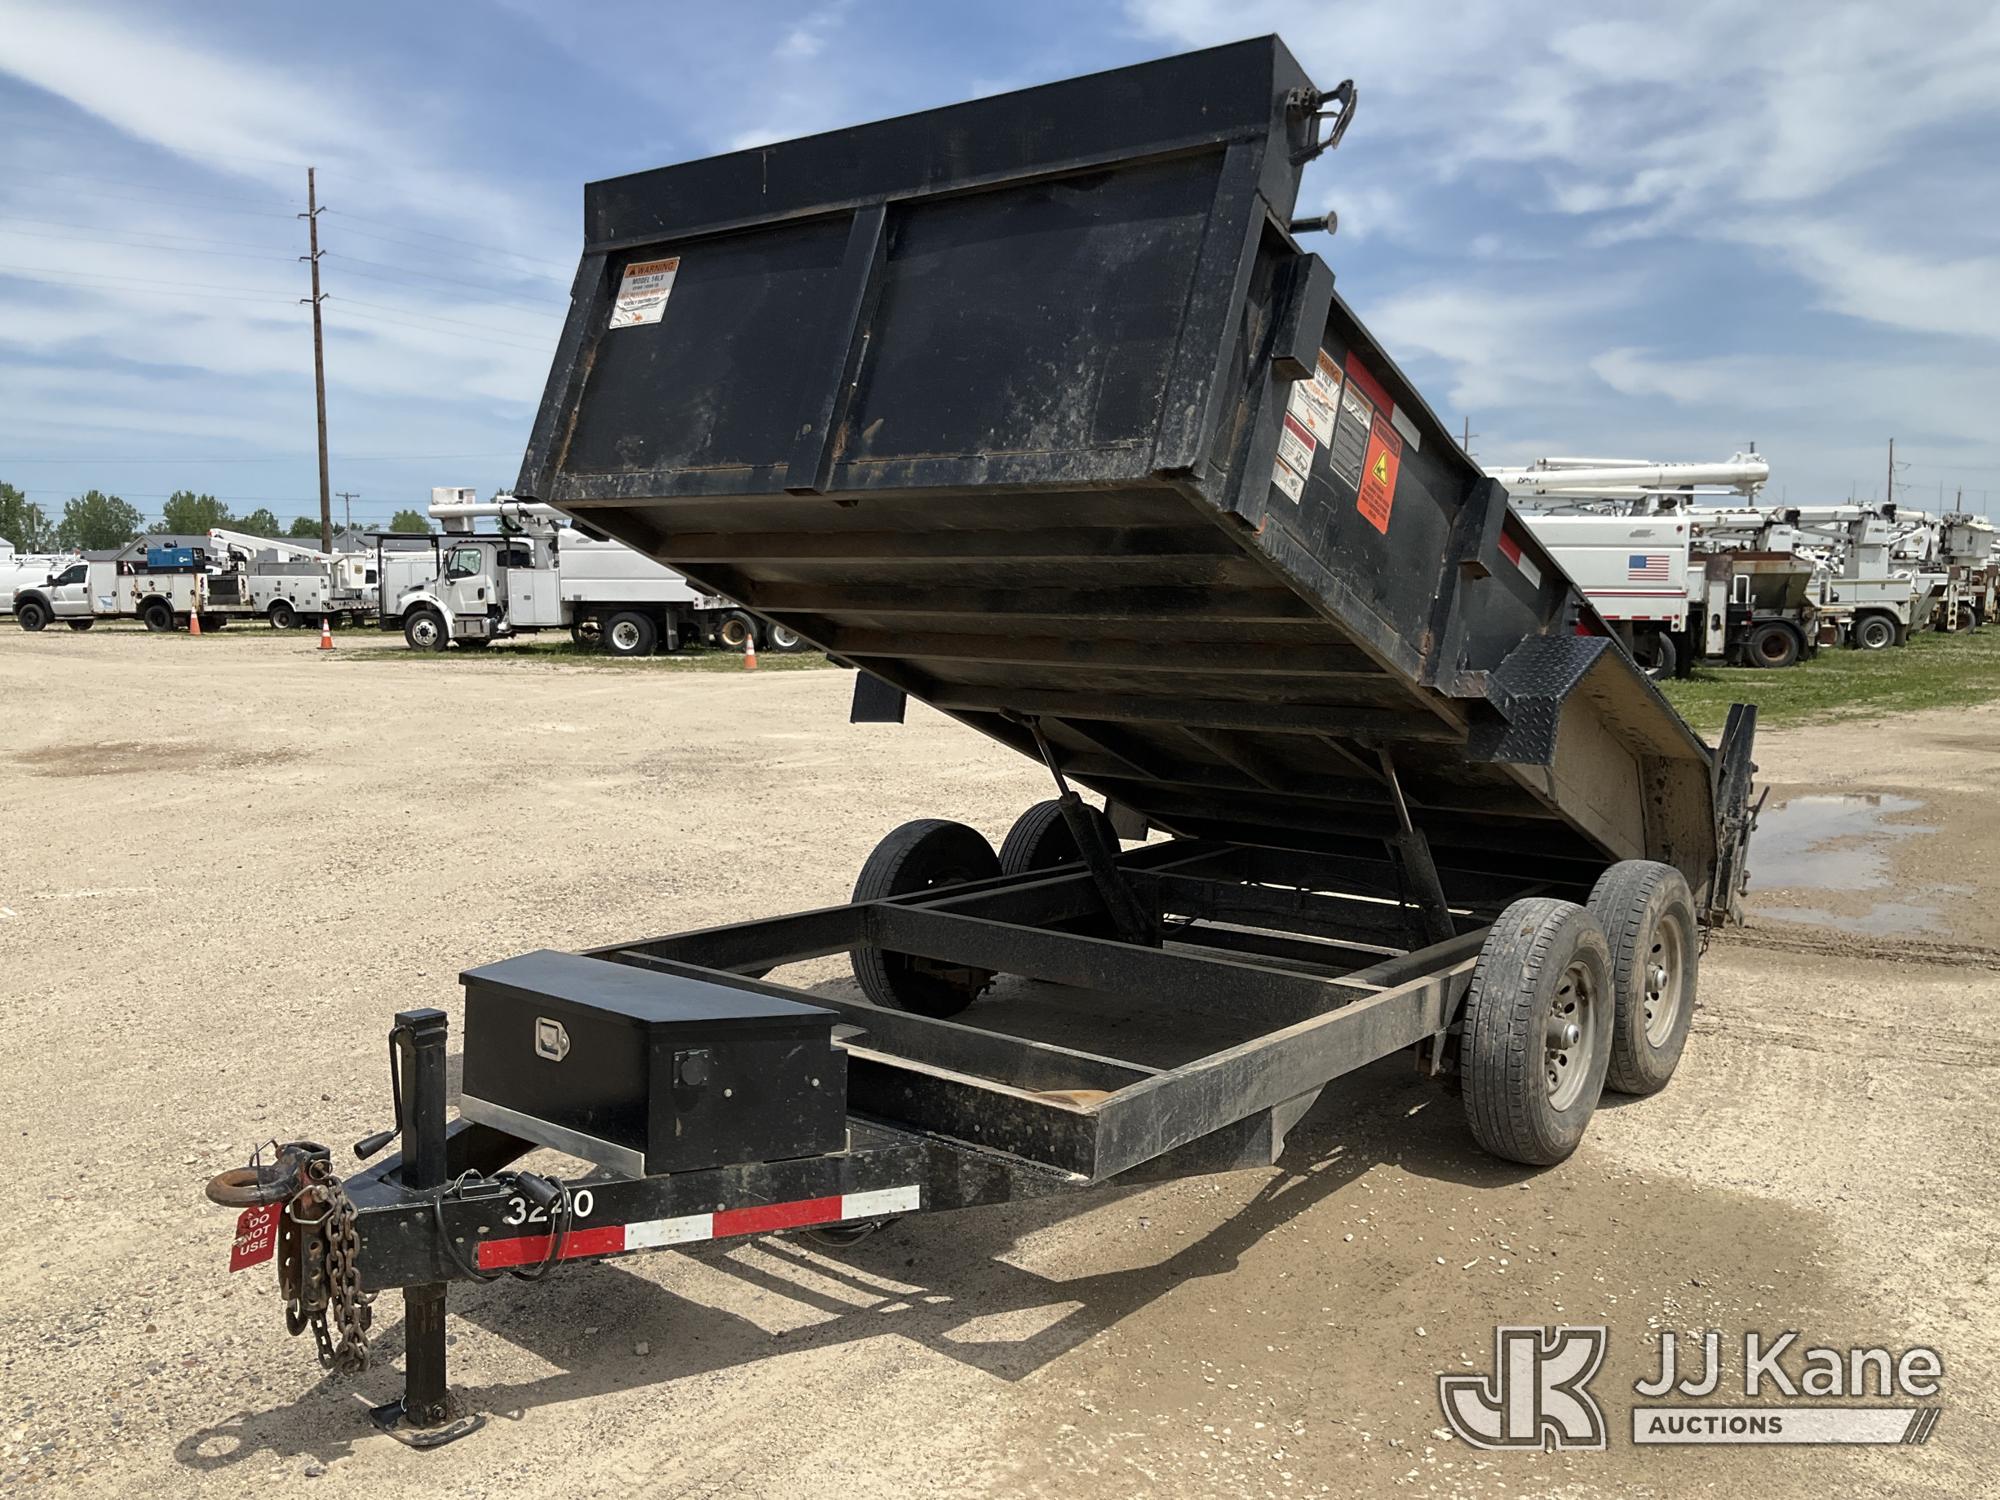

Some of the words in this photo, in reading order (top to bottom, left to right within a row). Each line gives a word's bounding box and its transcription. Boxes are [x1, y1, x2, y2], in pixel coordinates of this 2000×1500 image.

[638, 262, 674, 275] WARNING
[249, 1213, 270, 1228] DO
[243, 1224, 271, 1242] NOT
[240, 1237, 268, 1256] USE
